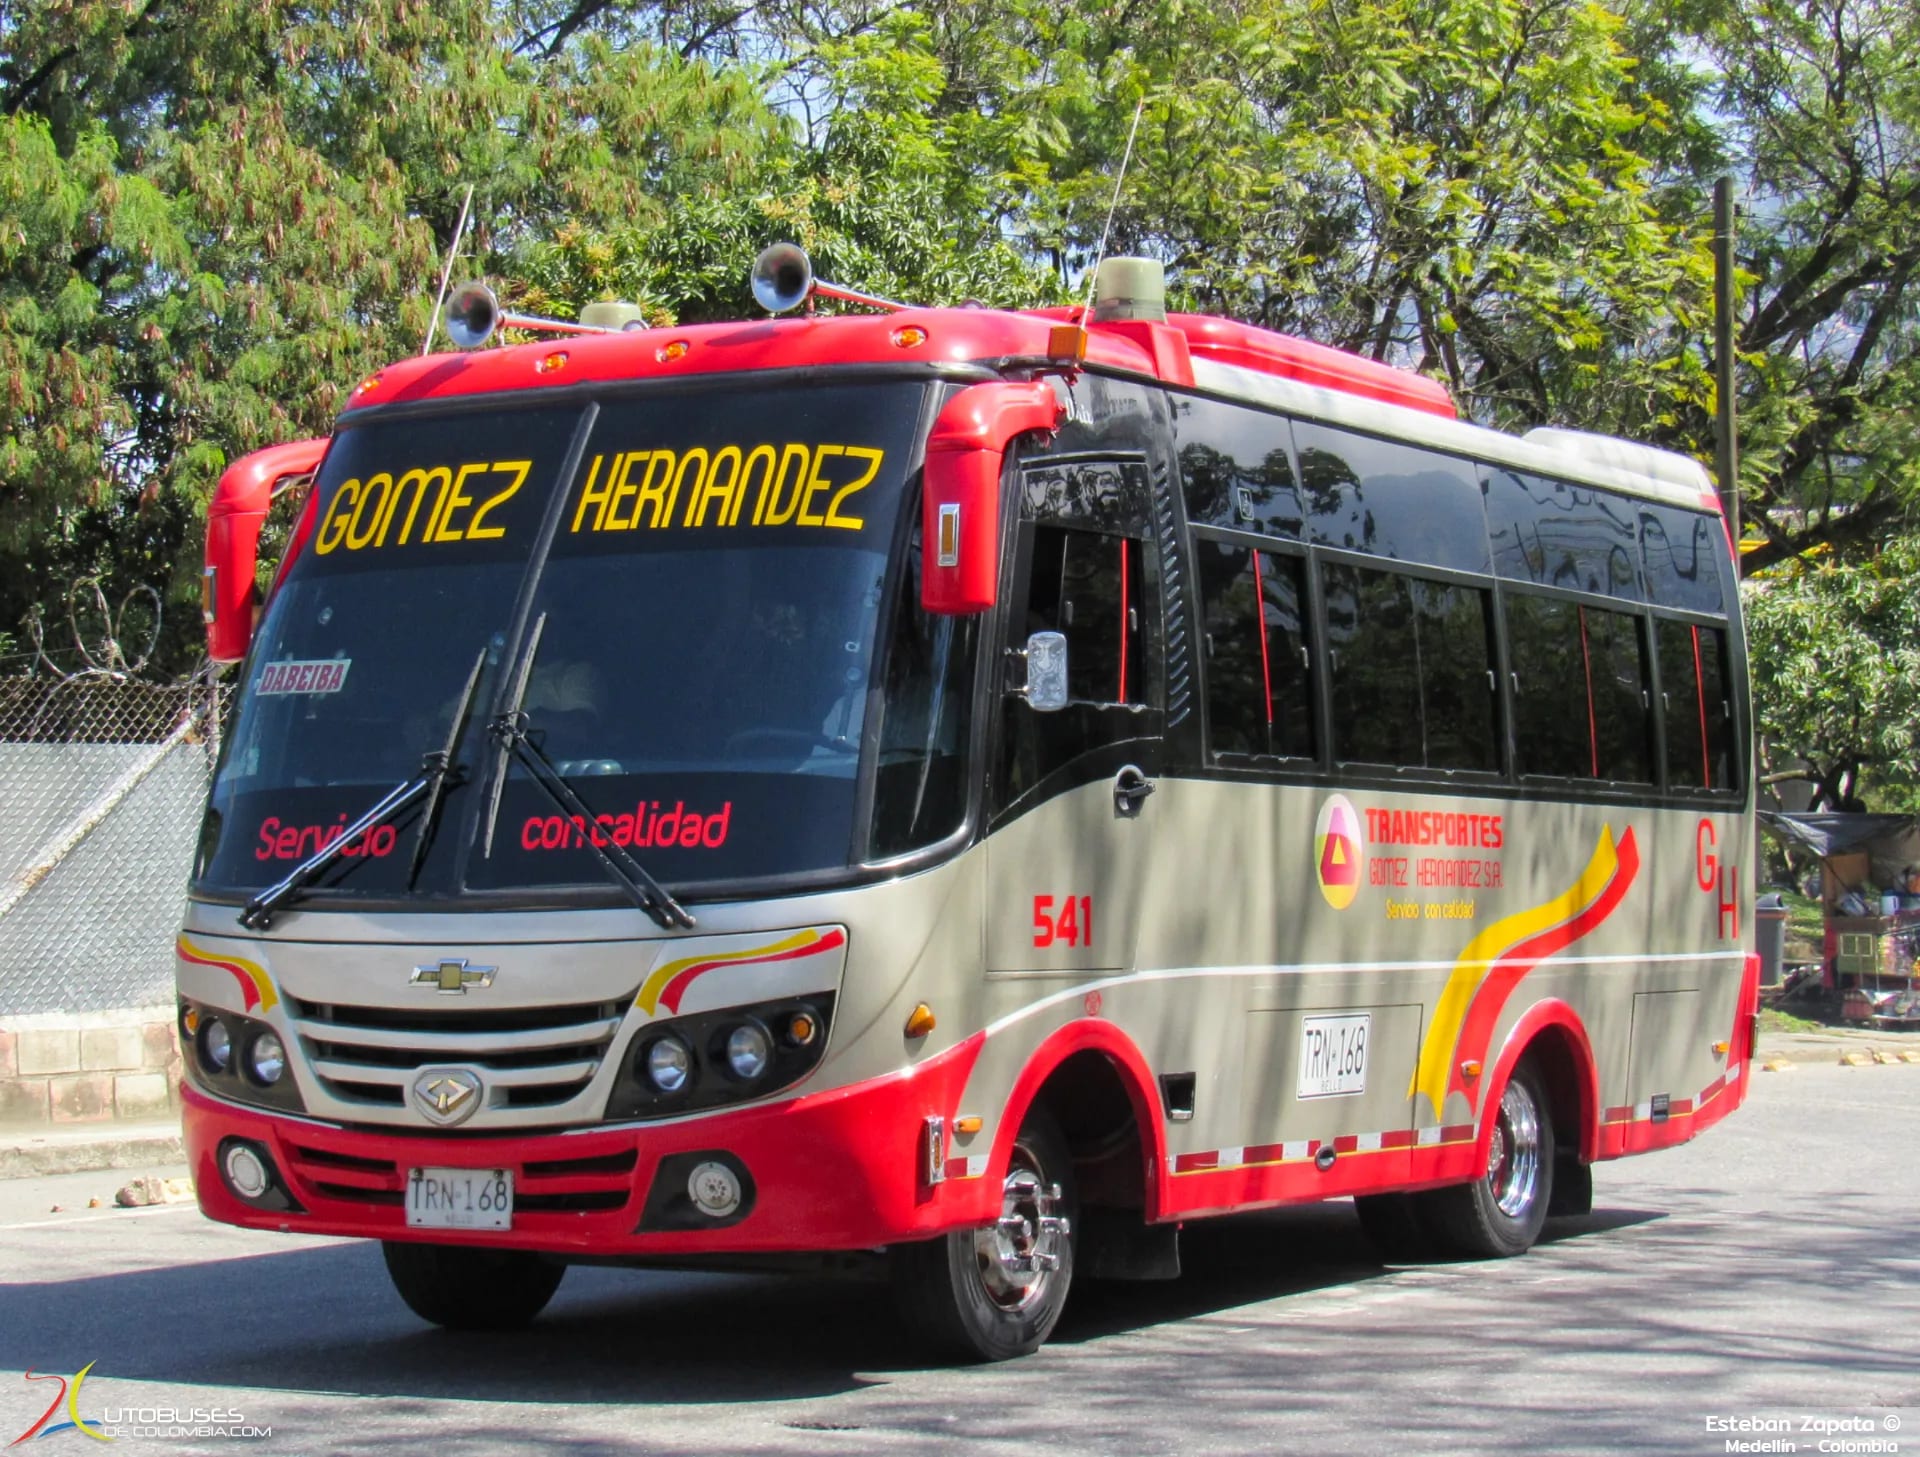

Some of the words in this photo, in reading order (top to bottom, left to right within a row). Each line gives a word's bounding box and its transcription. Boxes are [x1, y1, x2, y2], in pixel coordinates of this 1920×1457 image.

[315, 460, 533, 555] GOMEZ
[570, 443, 884, 533] HERNANDEZ
[259, 663, 345, 692] DABEIBA
[521, 815, 586, 851] con
[591, 800, 733, 848] calidad
[1365, 808, 1503, 848] TRANSPORTES
[1369, 857, 1409, 886] GOMEZ
[1416, 858, 1483, 888] HERNANDEZ
[1033, 894, 1092, 949] 541
